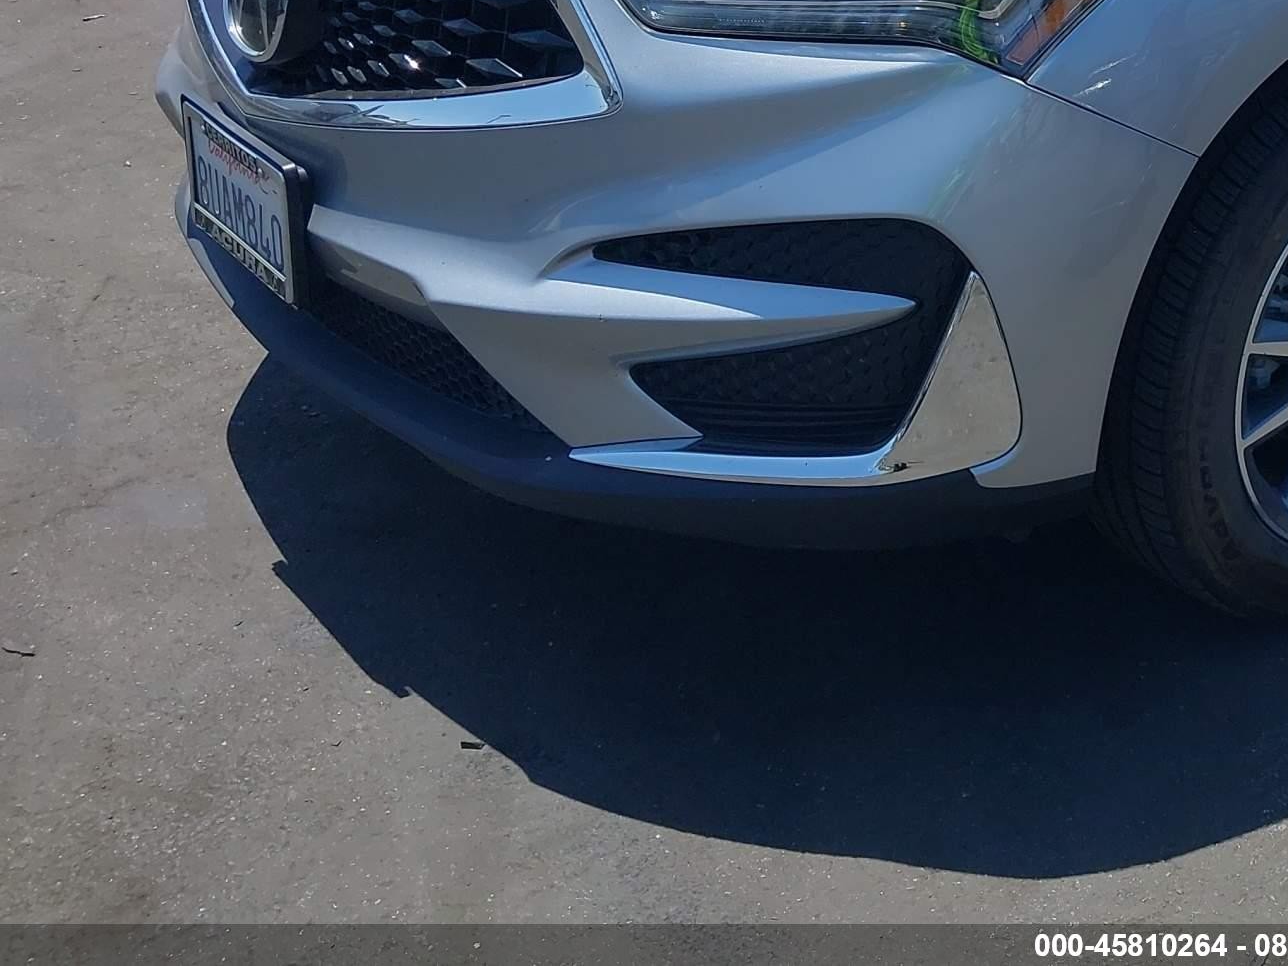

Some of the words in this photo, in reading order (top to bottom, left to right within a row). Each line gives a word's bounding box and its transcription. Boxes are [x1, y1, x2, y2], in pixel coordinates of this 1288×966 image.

[205, 123, 258, 172] CERRITOS
[197, 155, 284, 270] 8UAM840
[211, 225, 269, 280] ACURA
